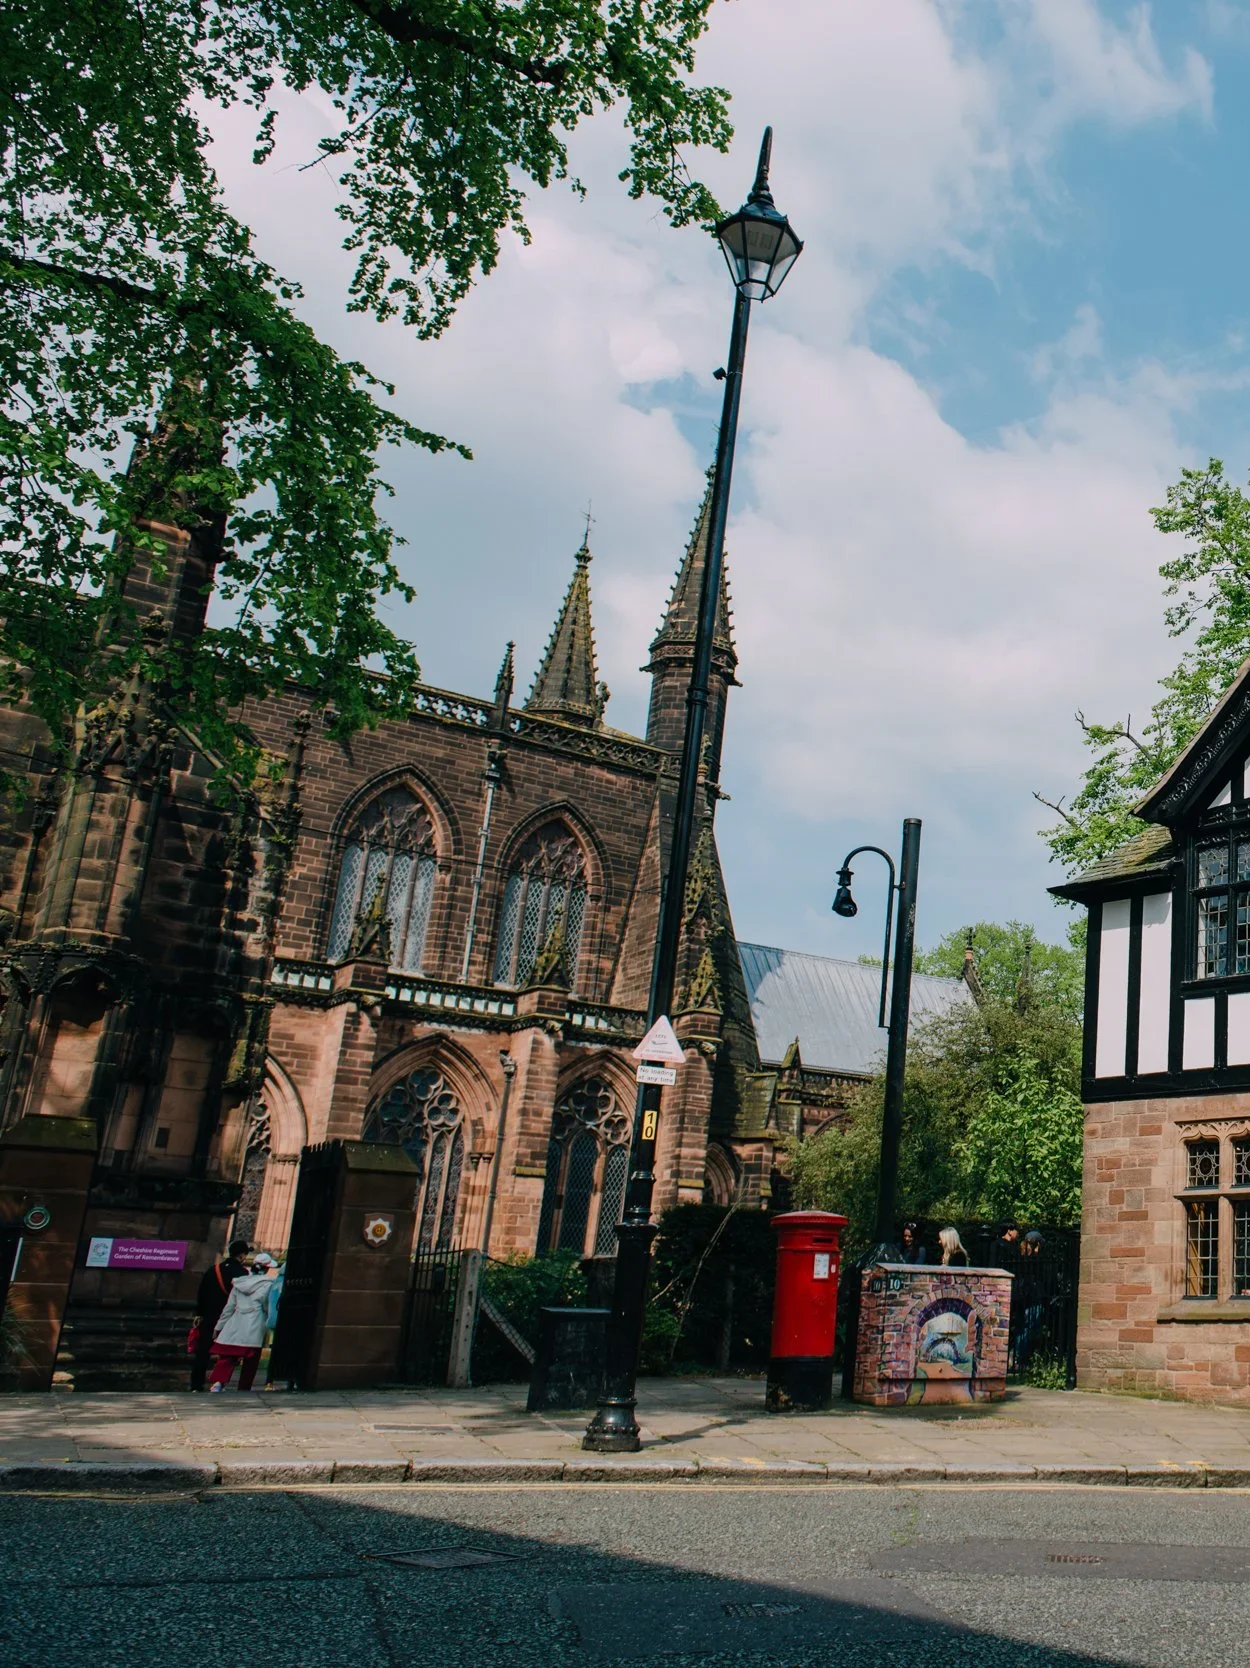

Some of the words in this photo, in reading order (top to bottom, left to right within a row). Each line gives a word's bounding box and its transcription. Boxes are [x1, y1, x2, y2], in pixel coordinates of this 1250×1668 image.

[651, 1069, 674, 1077] loading
[645, 1112, 653, 1138] 10
[890, 1279, 900, 1290] 10
